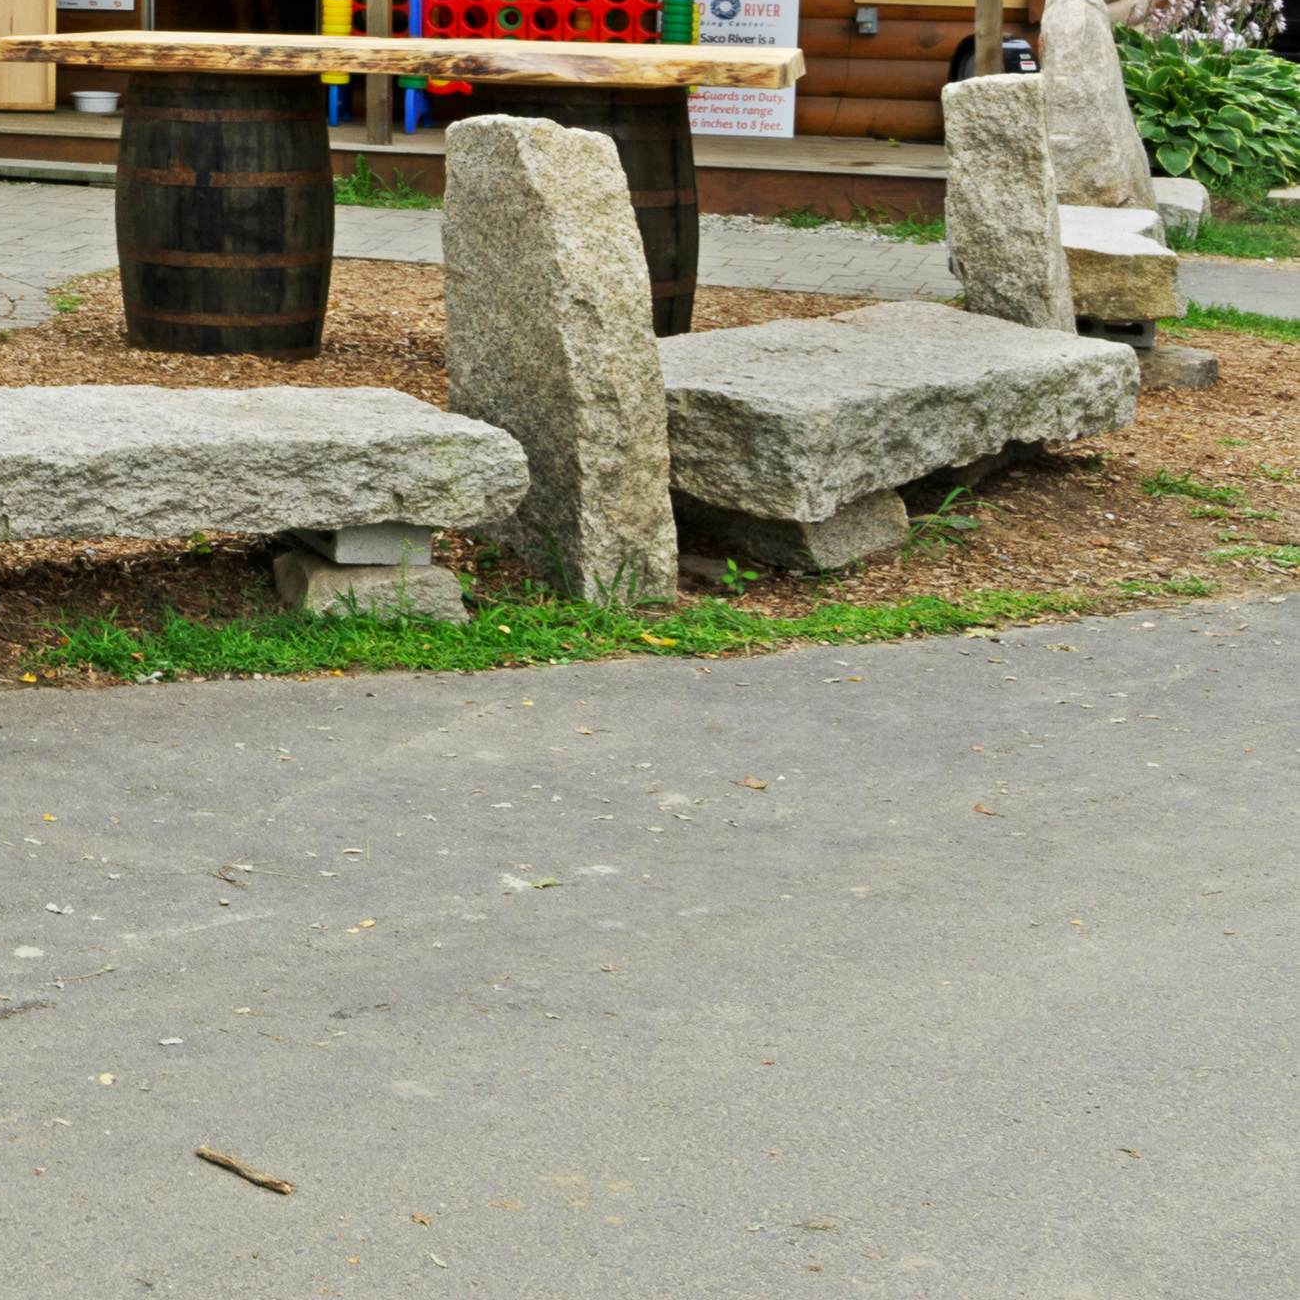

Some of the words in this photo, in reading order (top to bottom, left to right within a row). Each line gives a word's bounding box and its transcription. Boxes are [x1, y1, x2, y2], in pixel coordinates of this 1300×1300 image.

[744, 3, 781, 18] RIVER
[728, 20, 764, 28] Center
[700, 33, 726, 44] Saco
[728, 34, 757, 44] River
[758, 34, 767, 45] is
[768, 36, 775, 45] a
[703, 91, 739, 102] Guards
[742, 93, 756, 102] on
[758, 92, 786, 104] Duty.
[687, 105, 708, 114] ater
[710, 104, 740, 114] levels
[742, 107, 774, 119] range
[691, 118, 698, 127] 6
[701, 118, 733, 130] inches
[736, 120, 748, 130] to
[750, 120, 757, 130] 8
[758, 120, 784, 132] feet.
